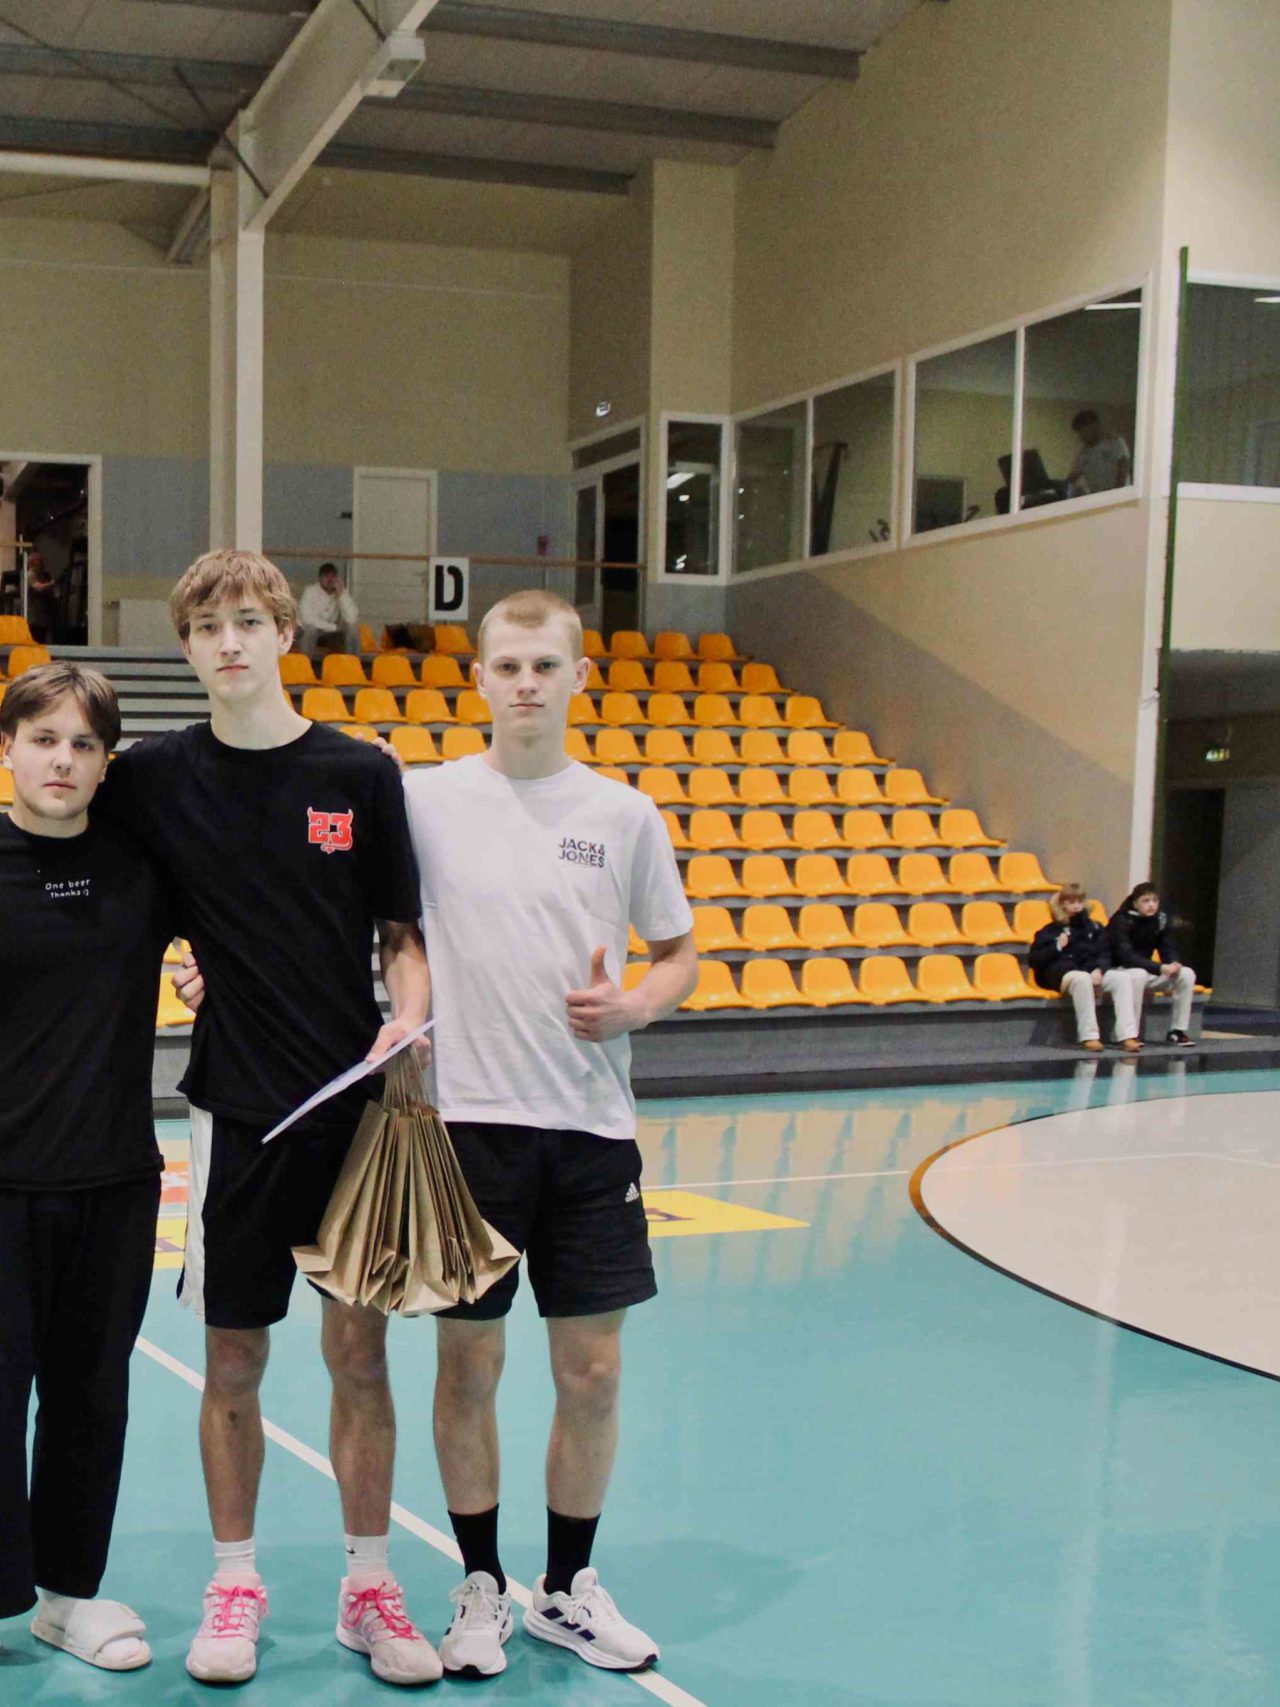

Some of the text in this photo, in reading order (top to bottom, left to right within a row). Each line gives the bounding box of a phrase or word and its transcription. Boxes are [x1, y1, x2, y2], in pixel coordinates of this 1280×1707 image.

[434, 564, 464, 612] D
[307, 807, 353, 850] 23
[558, 849, 605, 868] JONES
[45, 879, 91, 891] One beer
